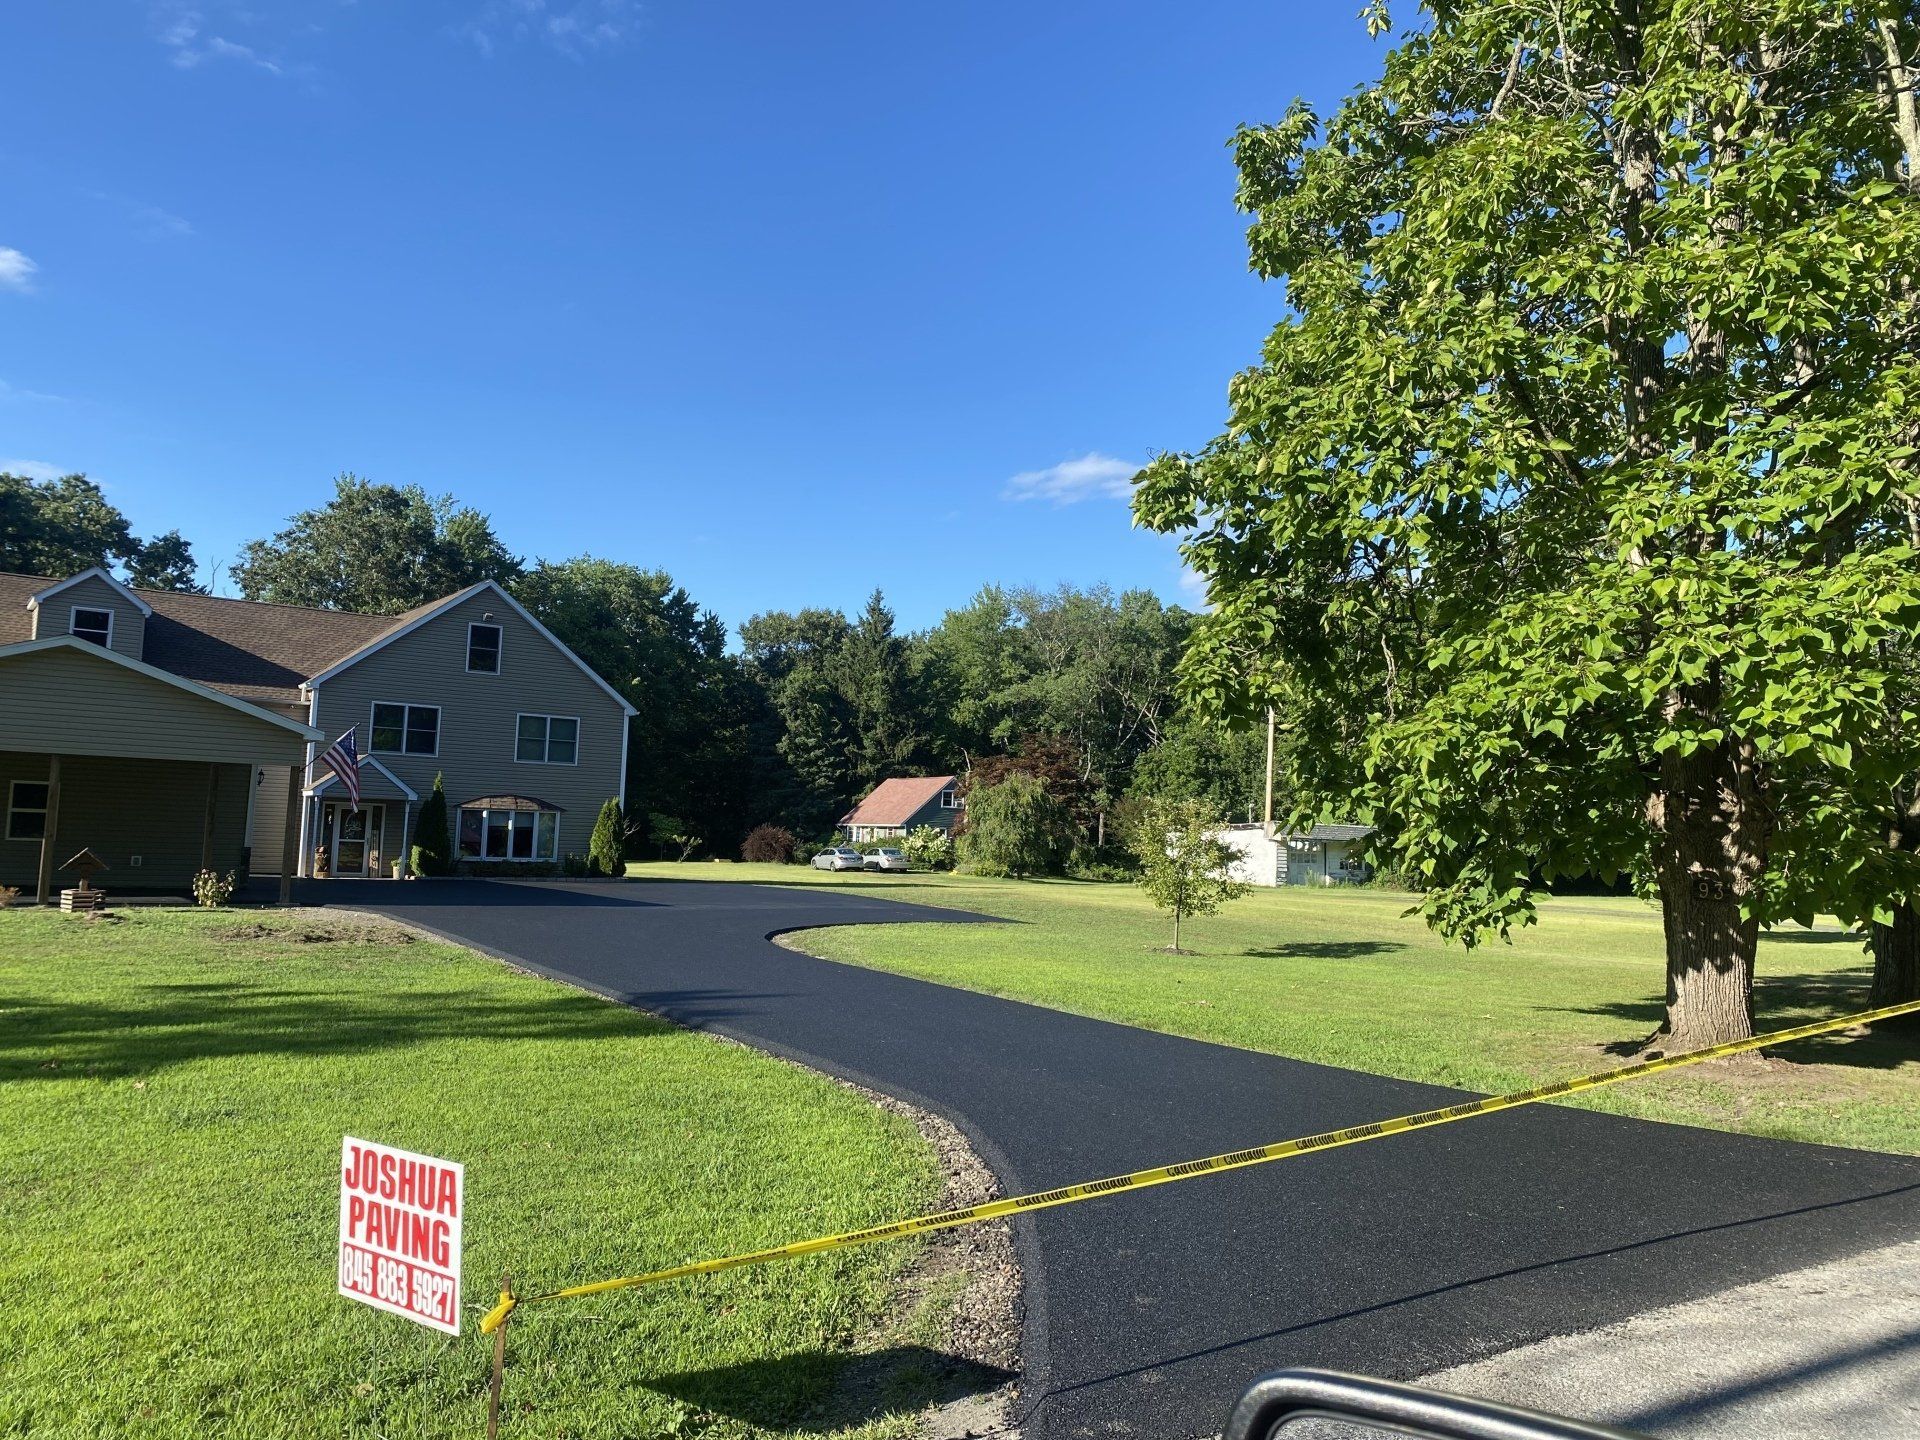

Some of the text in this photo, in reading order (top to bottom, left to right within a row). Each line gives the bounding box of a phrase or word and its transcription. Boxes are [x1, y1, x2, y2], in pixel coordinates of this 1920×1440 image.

[1699, 882, 1723, 899] 93
[345, 1146, 457, 1218] JOSHUA
[349, 1195, 450, 1268] PAVING
[343, 1246, 455, 1322] 845 883 5927
